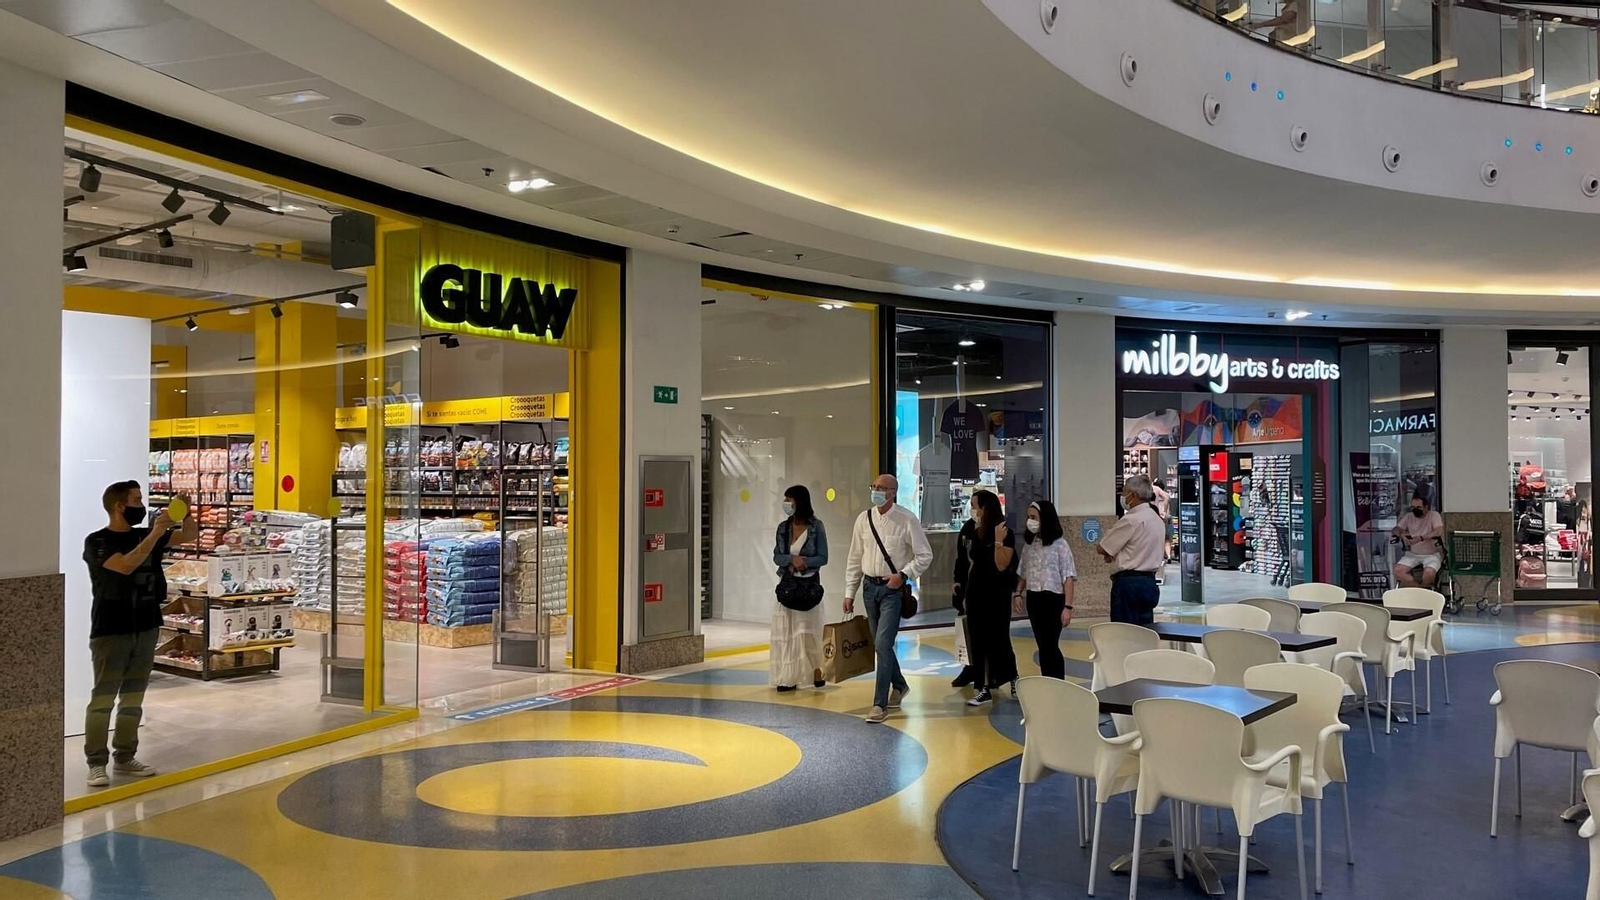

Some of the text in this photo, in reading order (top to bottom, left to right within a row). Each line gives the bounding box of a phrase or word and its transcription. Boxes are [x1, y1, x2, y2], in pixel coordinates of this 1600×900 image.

[421, 263, 578, 340] GUAW
[1122, 333, 1340, 394] milbby arts & crafts
[510, 403, 546, 411] Croooquetas
[953, 416, 966, 426] WE
[953, 429, 974, 439] LOVE
[953, 442, 963, 452] IT.
